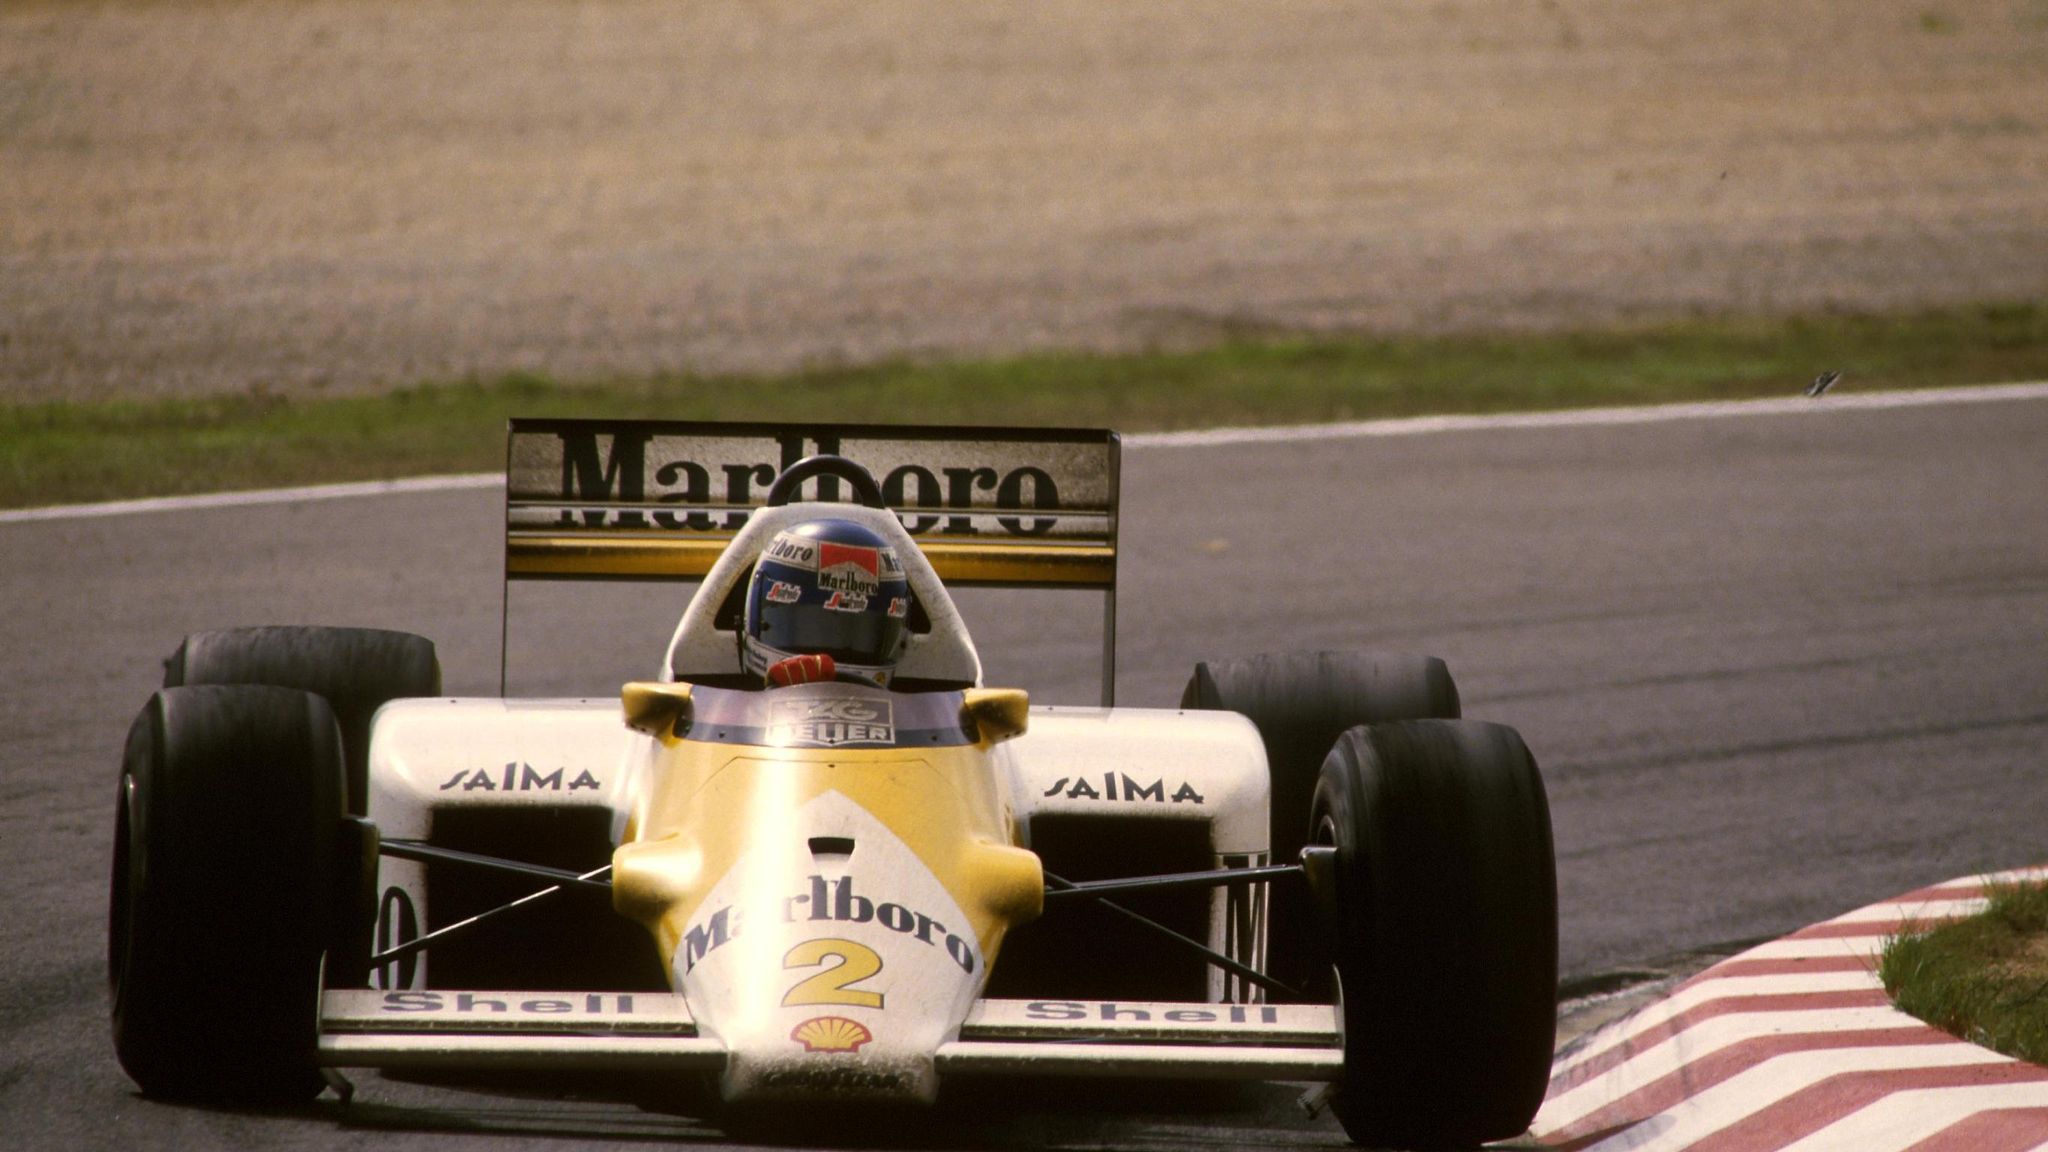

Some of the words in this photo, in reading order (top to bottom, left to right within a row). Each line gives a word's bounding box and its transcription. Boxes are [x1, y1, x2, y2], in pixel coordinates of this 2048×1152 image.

[820, 571, 878, 593] Marlboro
[773, 722, 888, 742] EUER
[440, 762, 601, 791] SAIMA
[1044, 772, 1204, 804] SAIMA
[684, 875, 974, 975] Mrlboro
[781, 937, 885, 1010] 2
[382, 993, 634, 1014] Shell
[1026, 1001, 1278, 1024] Shell
